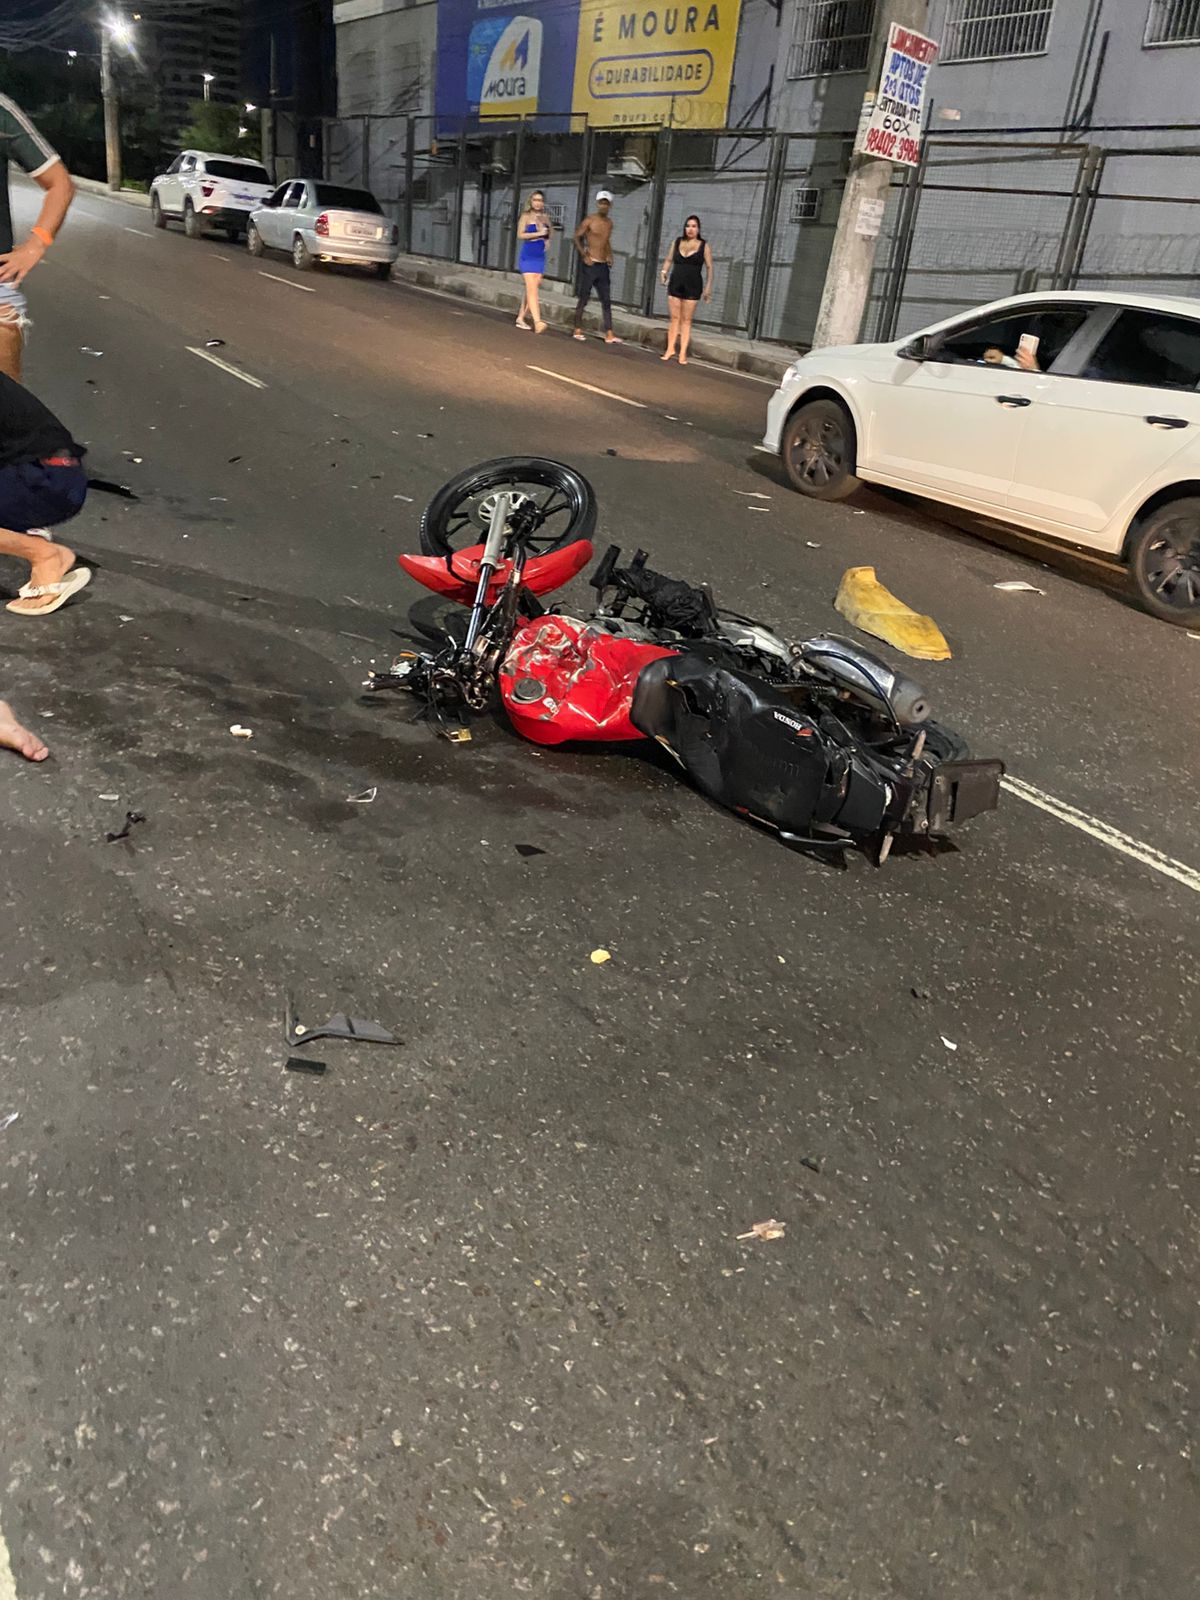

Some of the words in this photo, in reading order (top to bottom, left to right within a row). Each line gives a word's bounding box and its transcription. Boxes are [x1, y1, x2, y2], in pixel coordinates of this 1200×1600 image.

[593, 12, 604, 42] É
[618, 4, 720, 40] MOURA
[773, 711, 802, 731] HONDA
